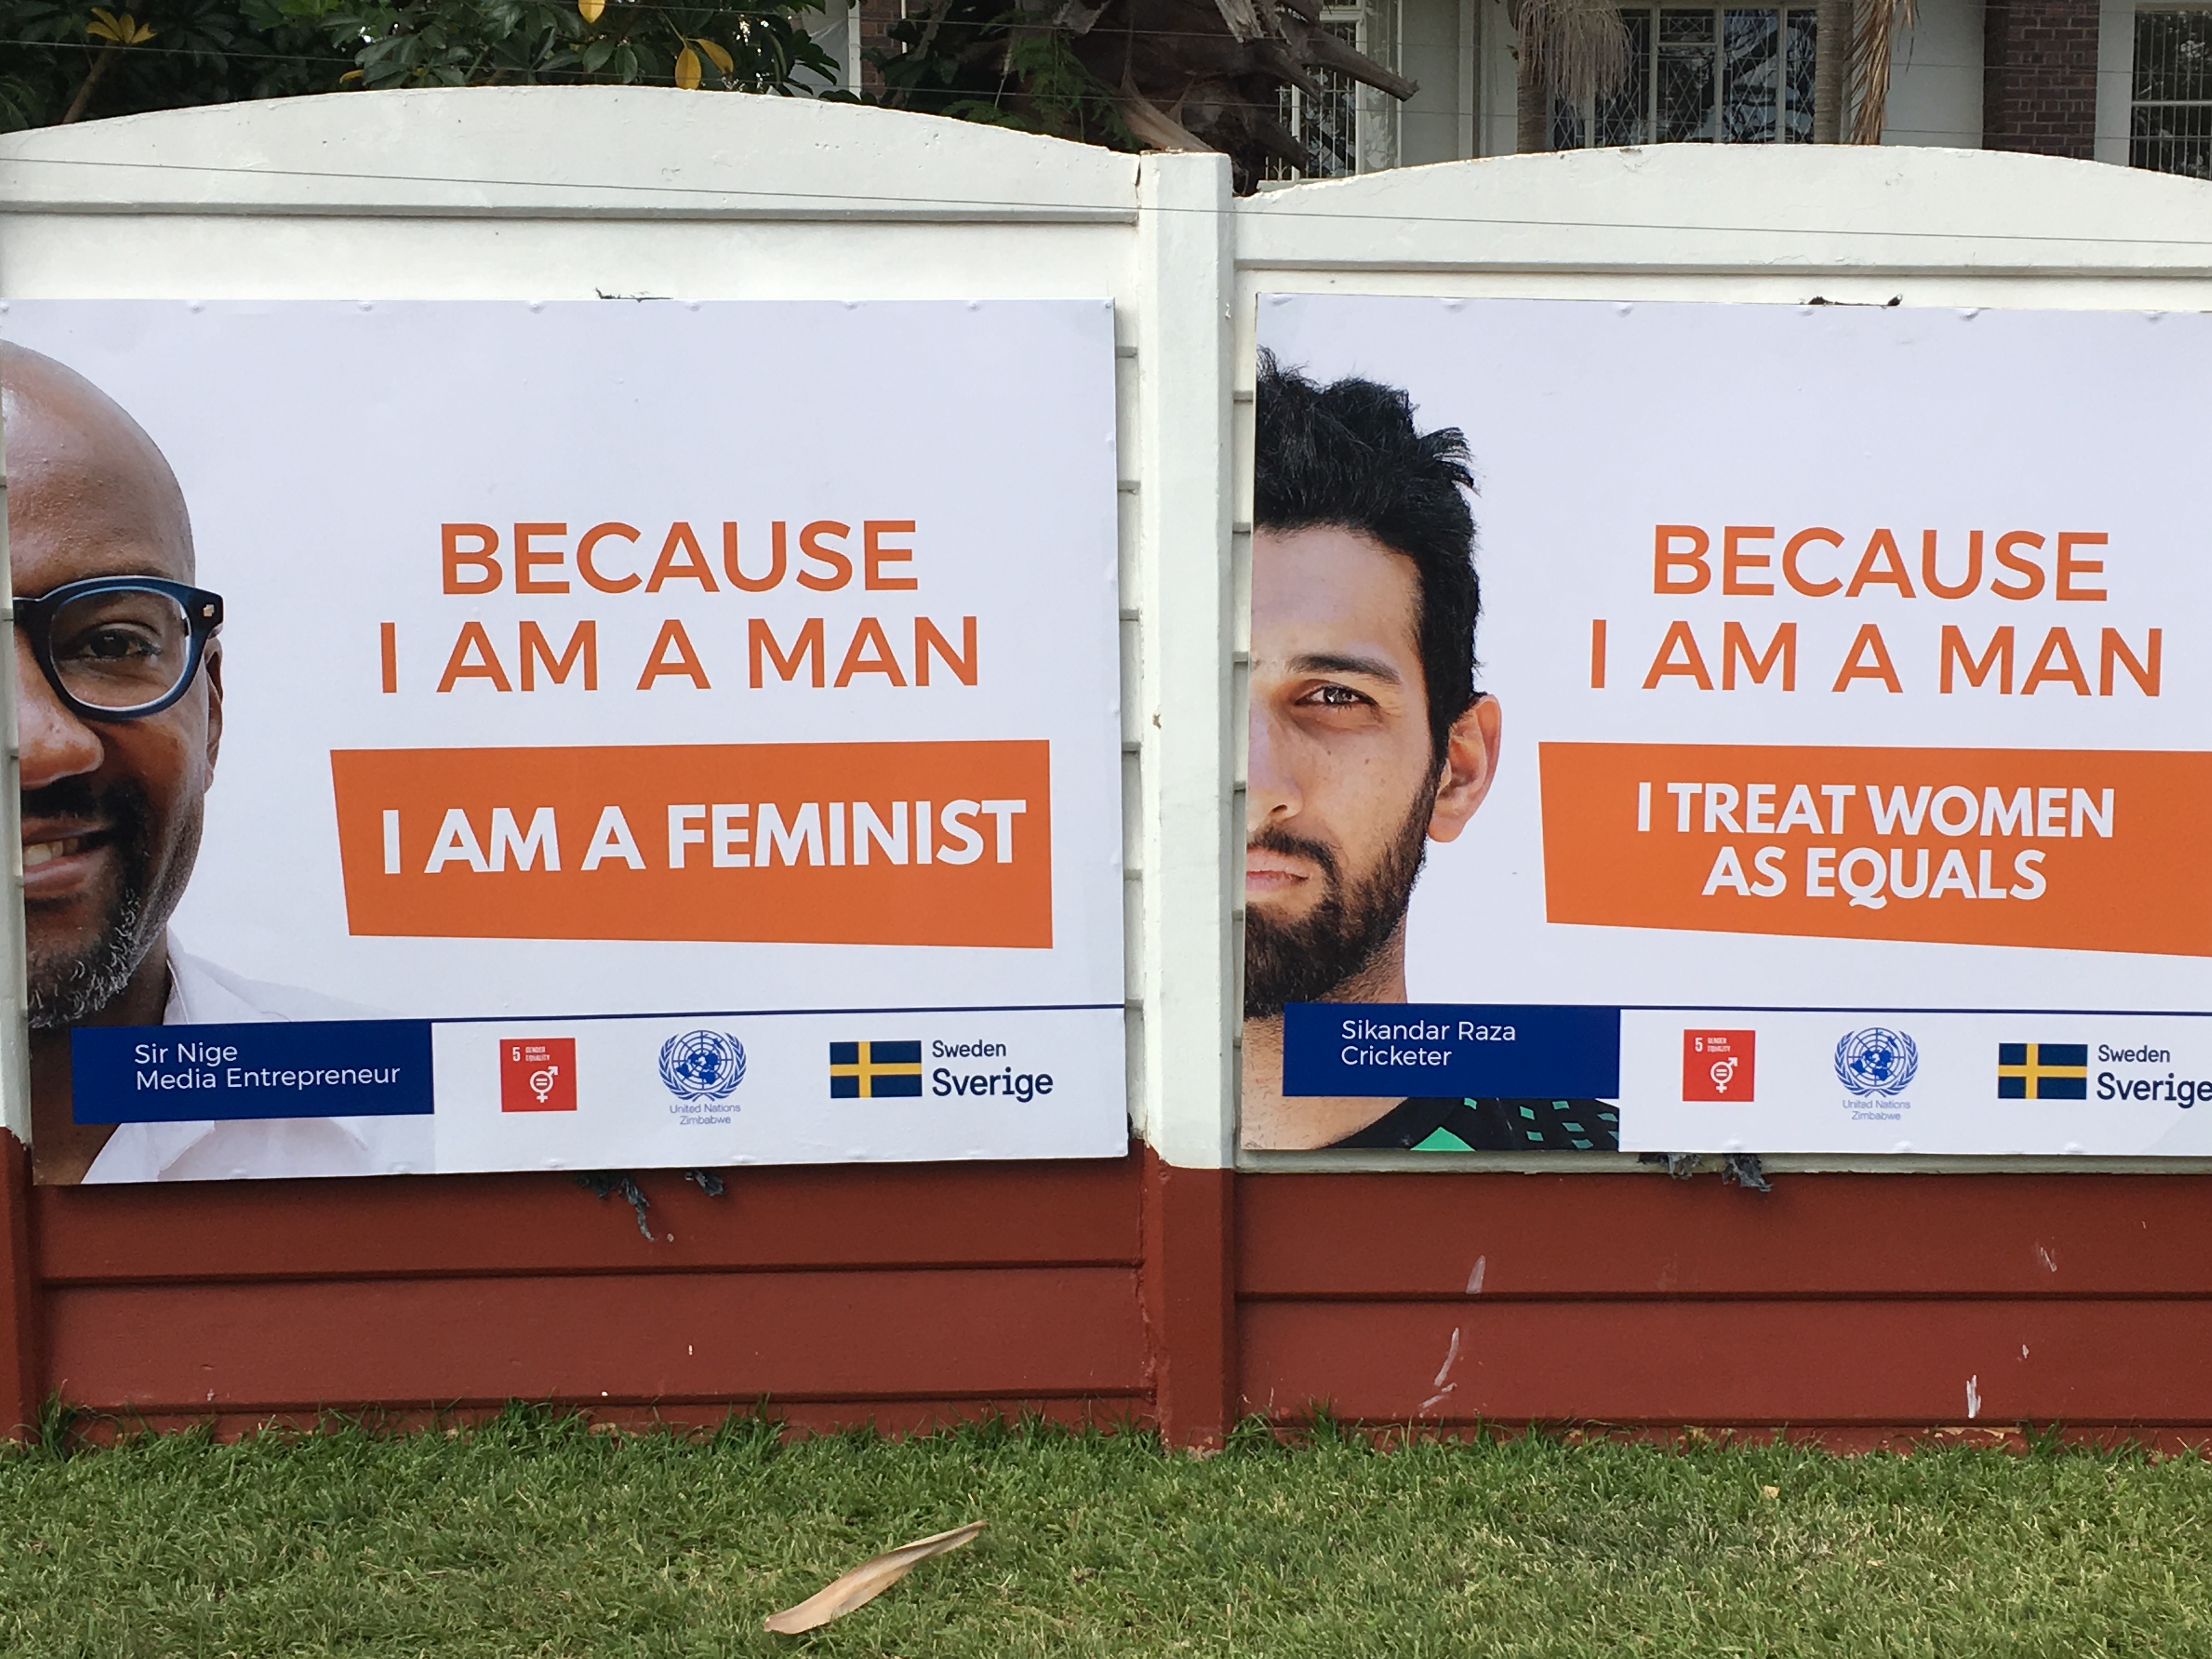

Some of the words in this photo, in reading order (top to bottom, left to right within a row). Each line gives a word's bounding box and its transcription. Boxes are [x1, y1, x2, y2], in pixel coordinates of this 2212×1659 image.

[441, 520, 918, 594] BECAUSE
[1654, 525, 2108, 601] BECAUSE
[381, 622, 397, 693] I
[436, 620, 597, 692] AM
[636, 619, 711, 690] A
[748, 616, 977, 689] MAN
[1592, 619, 1606, 688] I
[1642, 621, 1797, 691] AM
[1832, 624, 1903, 693] A
[1940, 625, 2162, 697] MAN
[1638, 782, 1651, 831] I
[1667, 783, 1855, 834] TREAT
[1866, 786, 2114, 837] WOMEN
[383, 810, 400, 874] I
[424, 808, 561, 873] AM
[581, 806, 646, 870] A
[668, 799, 1026, 868] FEMINIST
[1702, 847, 1786, 897] AS
[1807, 848, 2046, 909] EQUALS
[1342, 1019, 1450, 1040] Sikandar
[1459, 1022, 1515, 1041] Raza
[135, 1043, 168, 1064] Sir
[178, 1042, 237, 1066] Nige
[513, 1047, 520, 1061] 5
[932, 1040, 1006, 1057] Sweden
[1342, 1045, 1452, 1065] Cricketer
[1695, 1037, 1702, 1052] 5
[2098, 1045, 2170, 1062] Sweden
[137, 1068, 216, 1090] Media
[227, 1068, 400, 1090] Entrepreneur
[933, 1066, 1053, 1103] Sverige
[2097, 1072, 2212, 1109] Sverige
[670, 1104, 701, 1114] United
[704, 1104, 741, 1113] Nations
[1843, 1100, 1872, 1109] United
[1876, 1100, 1911, 1109] Nations
[1852, 1111, 1901, 1120] Zimbabwe
[680, 1115, 731, 1125] Zimbabwe
